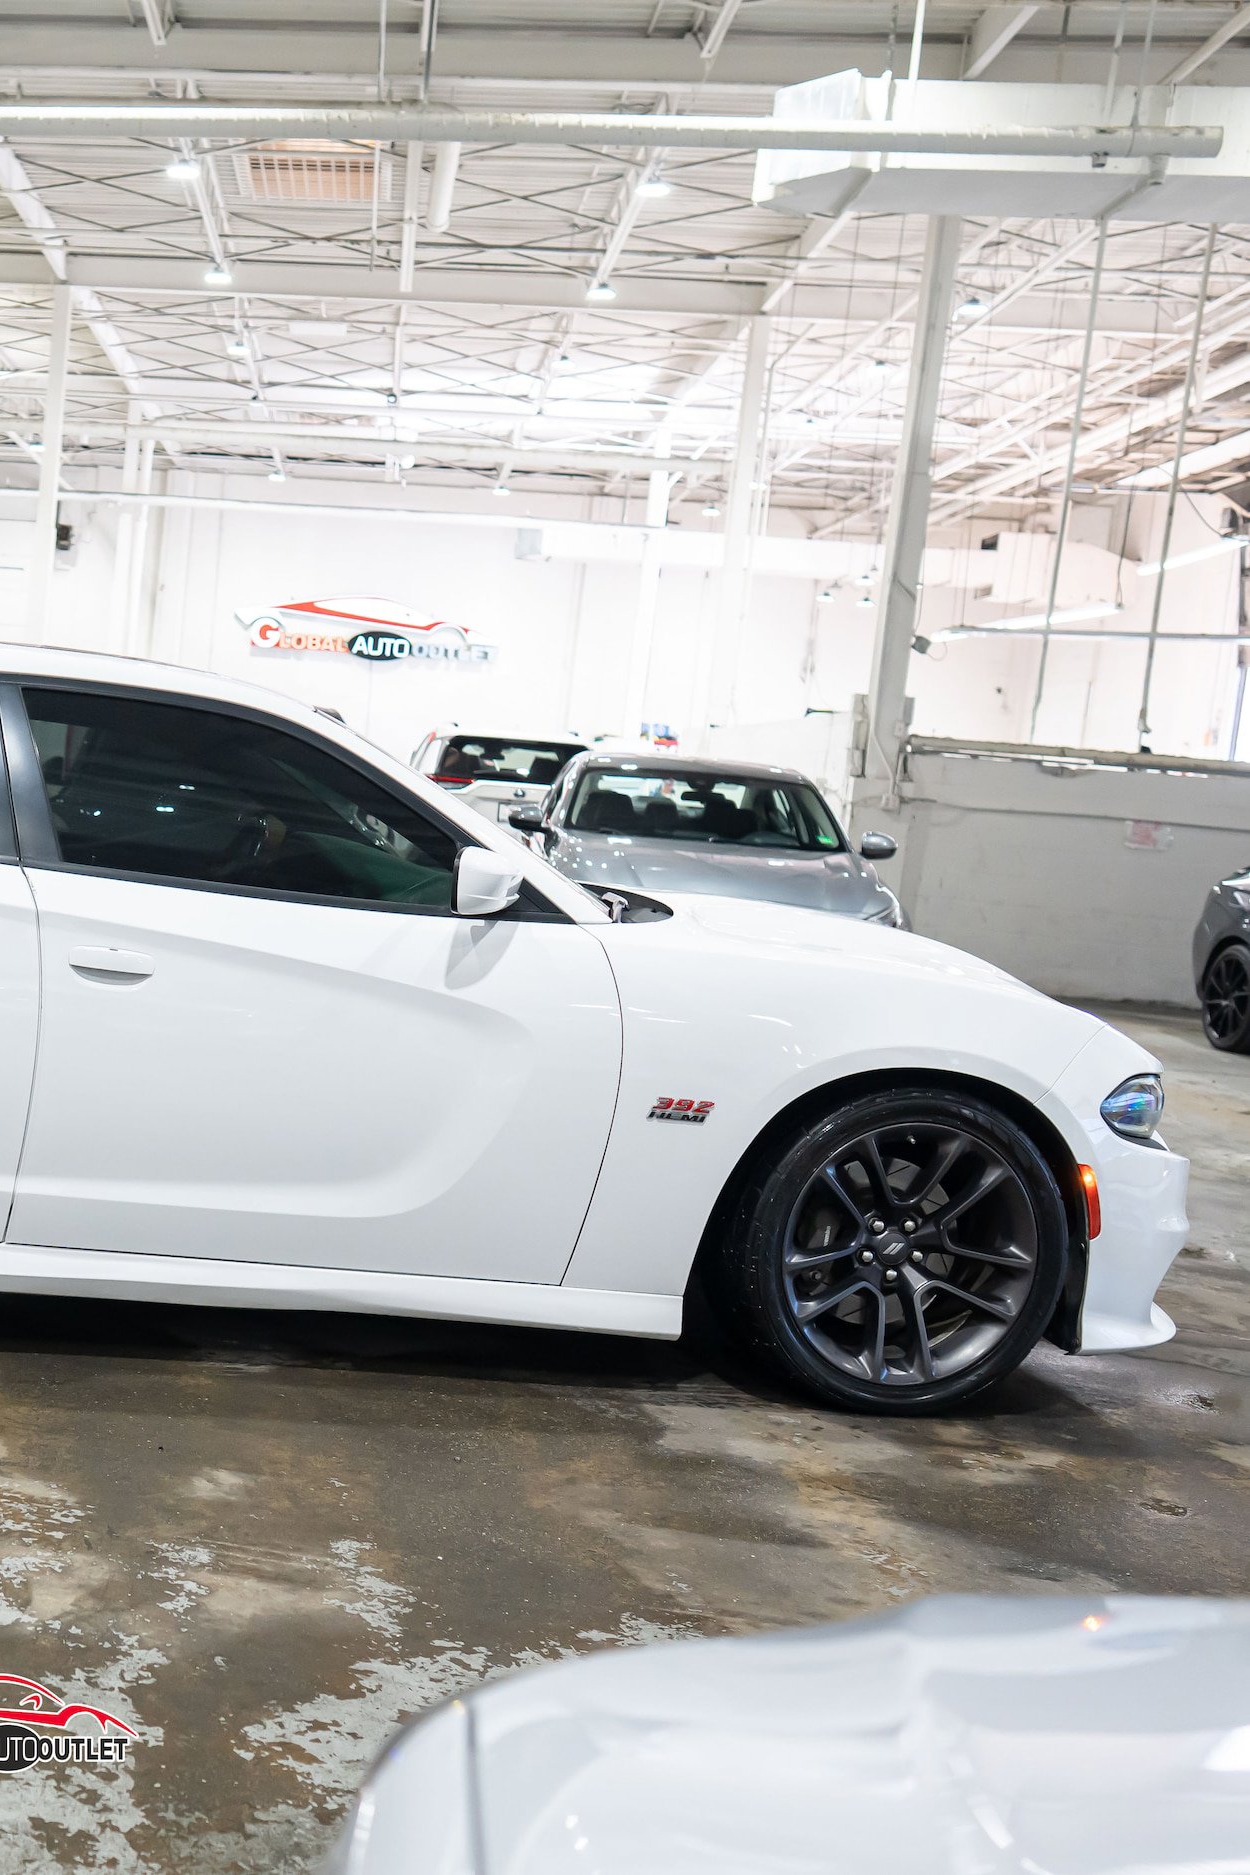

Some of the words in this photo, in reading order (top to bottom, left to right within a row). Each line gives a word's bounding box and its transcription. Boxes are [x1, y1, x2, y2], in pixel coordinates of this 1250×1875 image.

[250, 616, 349, 653] GLOBAL
[351, 636, 410, 657] AUTO
[652, 1097, 715, 1113] 392
